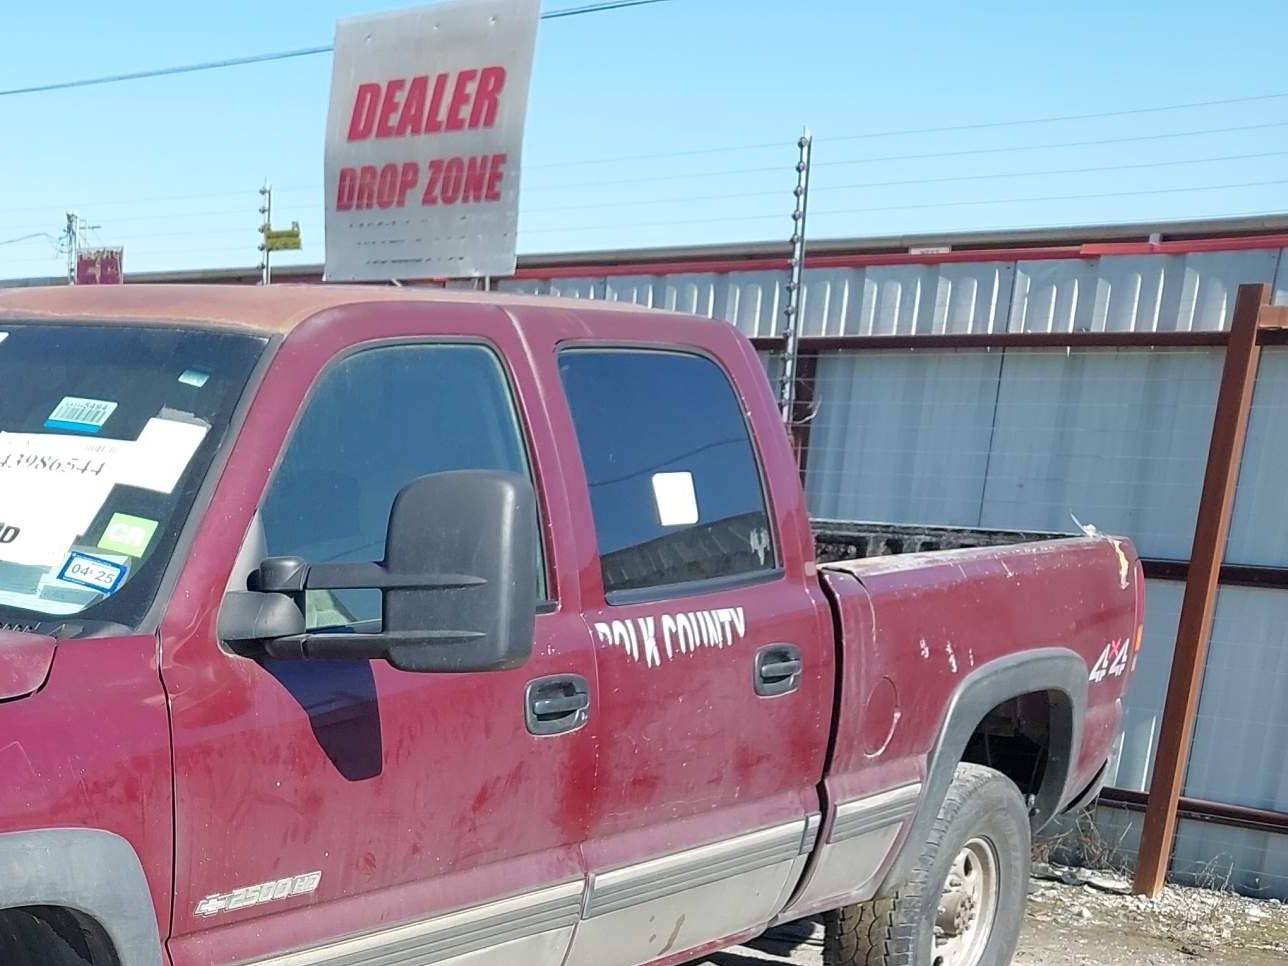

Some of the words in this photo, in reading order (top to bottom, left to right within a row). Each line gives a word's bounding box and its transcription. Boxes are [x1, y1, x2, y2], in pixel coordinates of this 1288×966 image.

[347, 66, 507, 143] DEALER
[336, 160, 419, 212] DROP
[421, 153, 507, 206] ZONE
